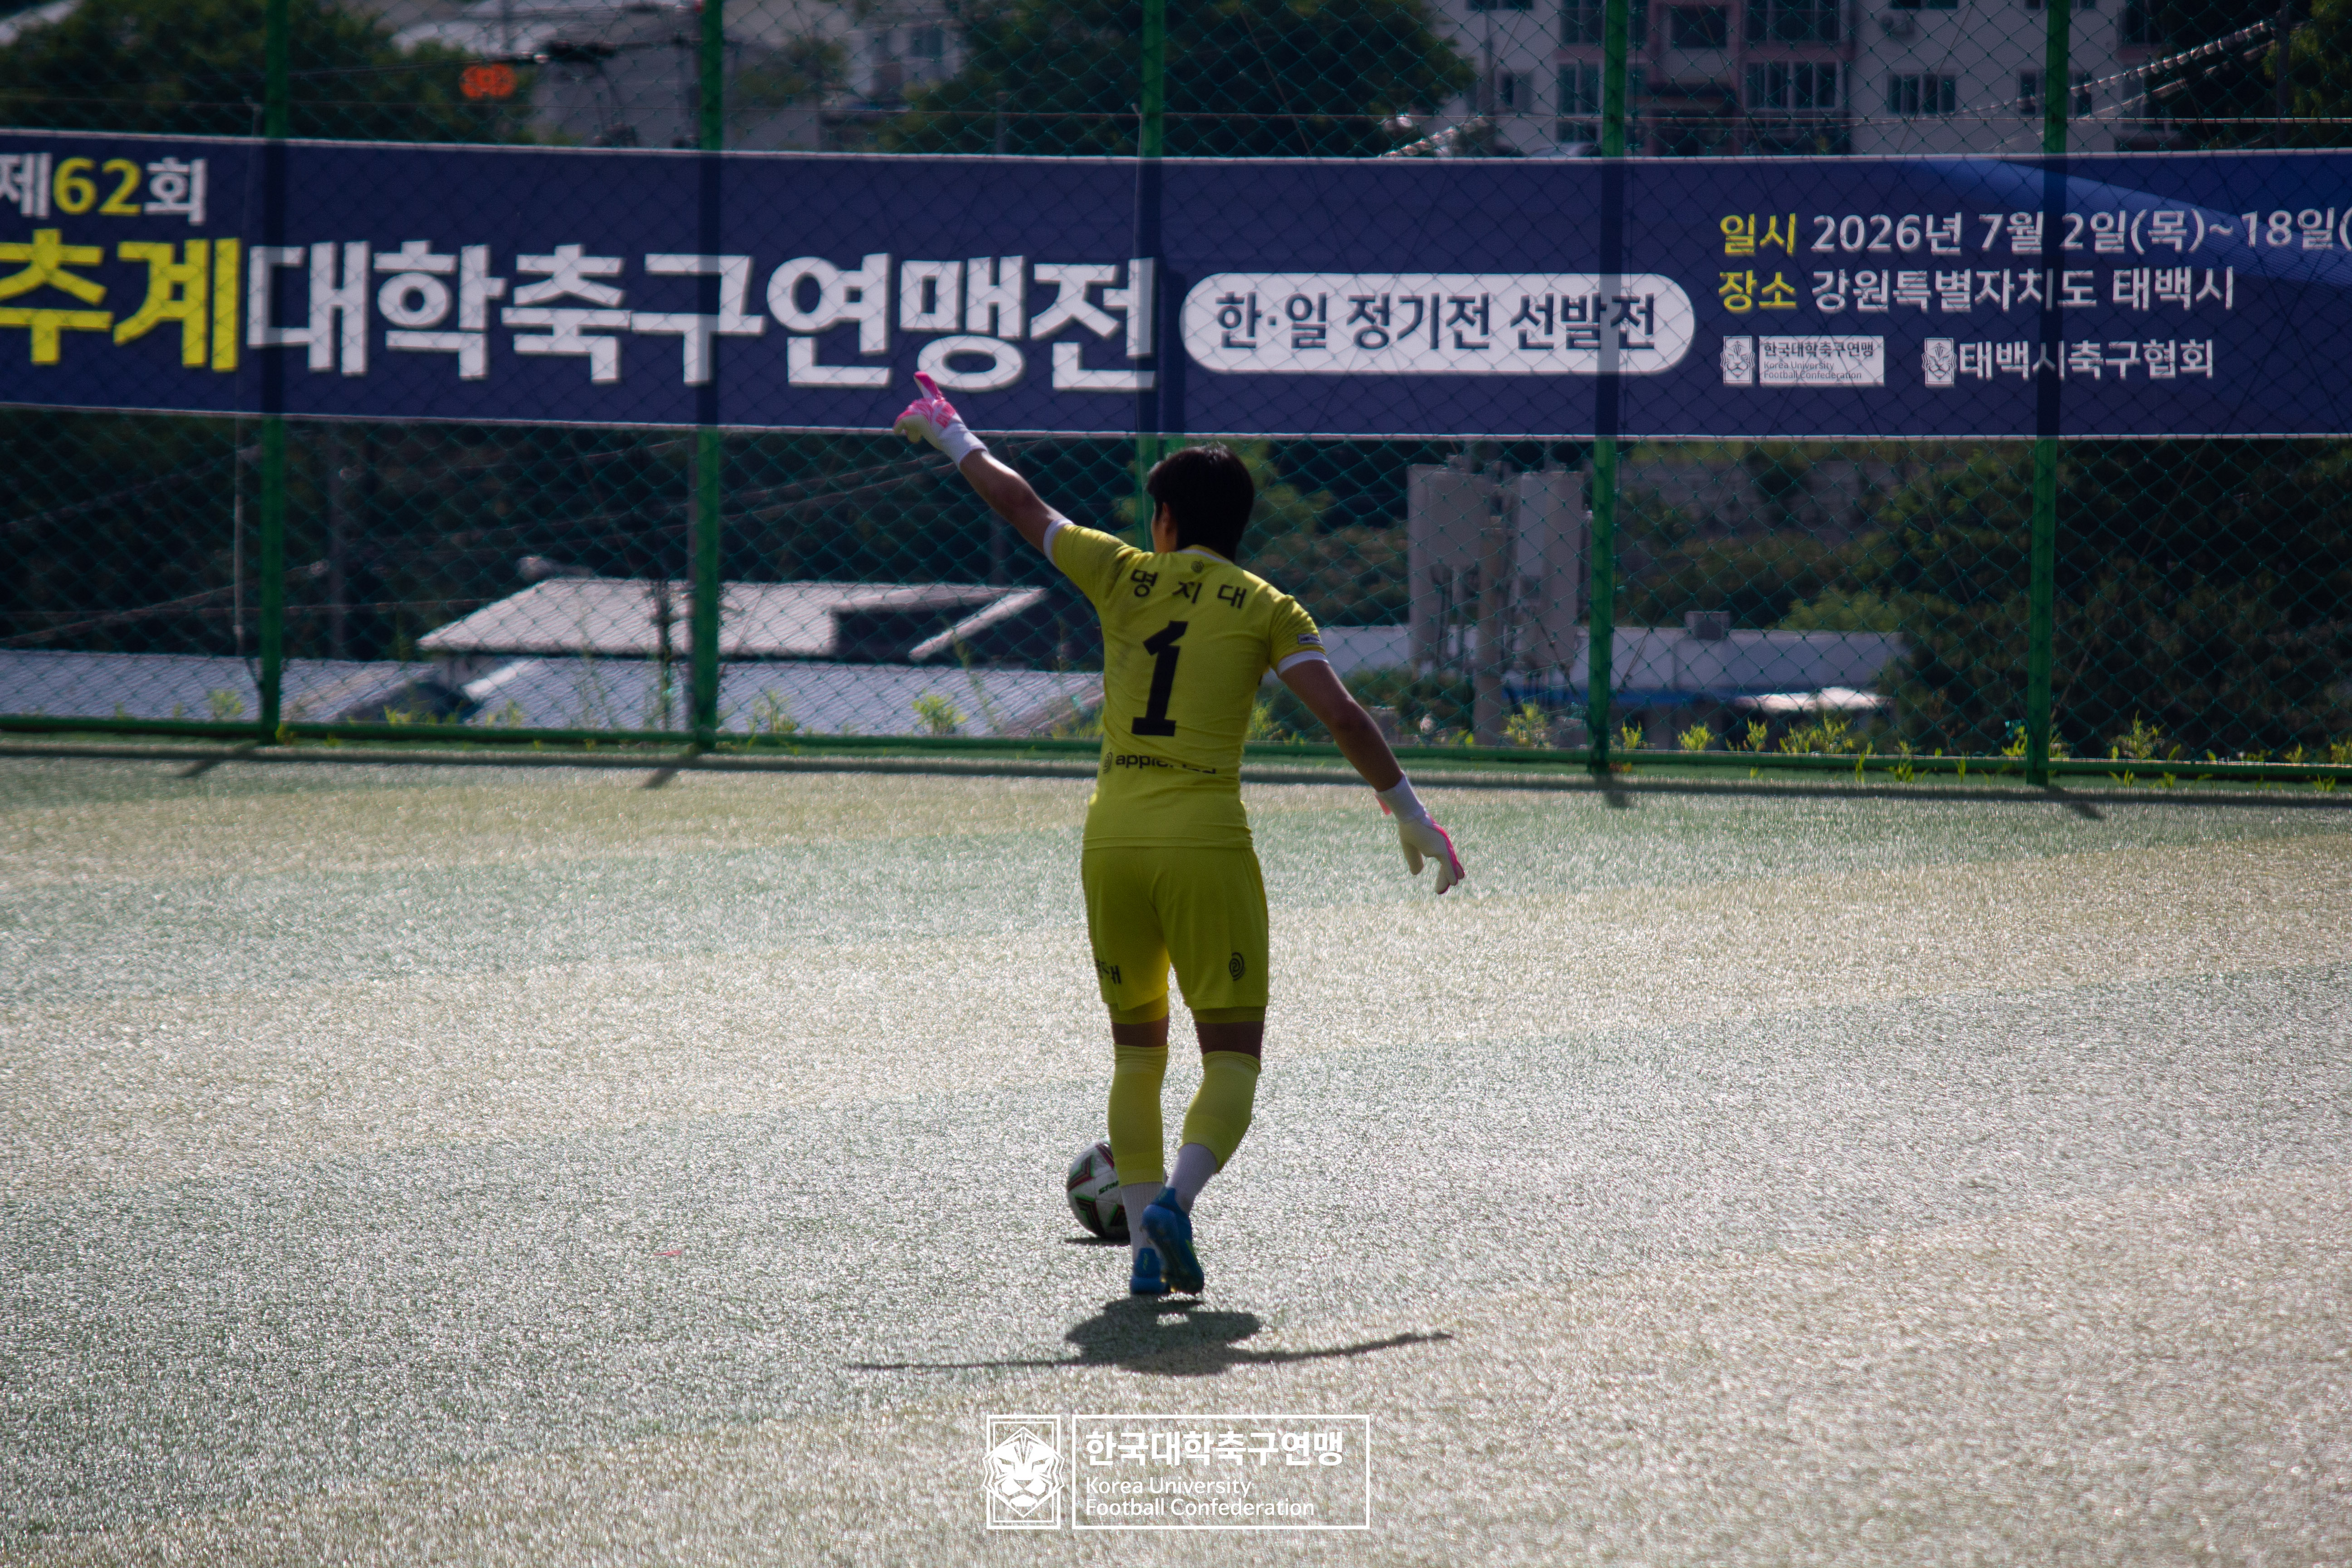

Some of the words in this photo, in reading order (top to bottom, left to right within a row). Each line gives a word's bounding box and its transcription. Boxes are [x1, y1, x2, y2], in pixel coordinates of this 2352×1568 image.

[0, 152, 208, 225] 제62회
[1720, 213, 1796, 255] 일시
[1811, 212, 1962, 255] 2026년
[1979, 211, 2044, 255] 7월
[1719, 270, 1797, 313] 장소
[1812, 268, 2097, 313] 강원특별자치도
[2112, 266, 2234, 311] 태백시
[1215, 291, 1328, 350] 한·일
[1346, 292, 1490, 350] 정기전
[1510, 292, 1656, 350] 선발전
[1764, 341, 1873, 357] 한국대학축구연맹
[1764, 361, 1789, 370] Korea
[1791, 361, 1834, 371] University
[1960, 339, 2213, 381] 태백시축구협회
[1764, 370, 1798, 379] Football
[1800, 370, 1862, 379] Confederation
[1131, 620, 1189, 737] 1
